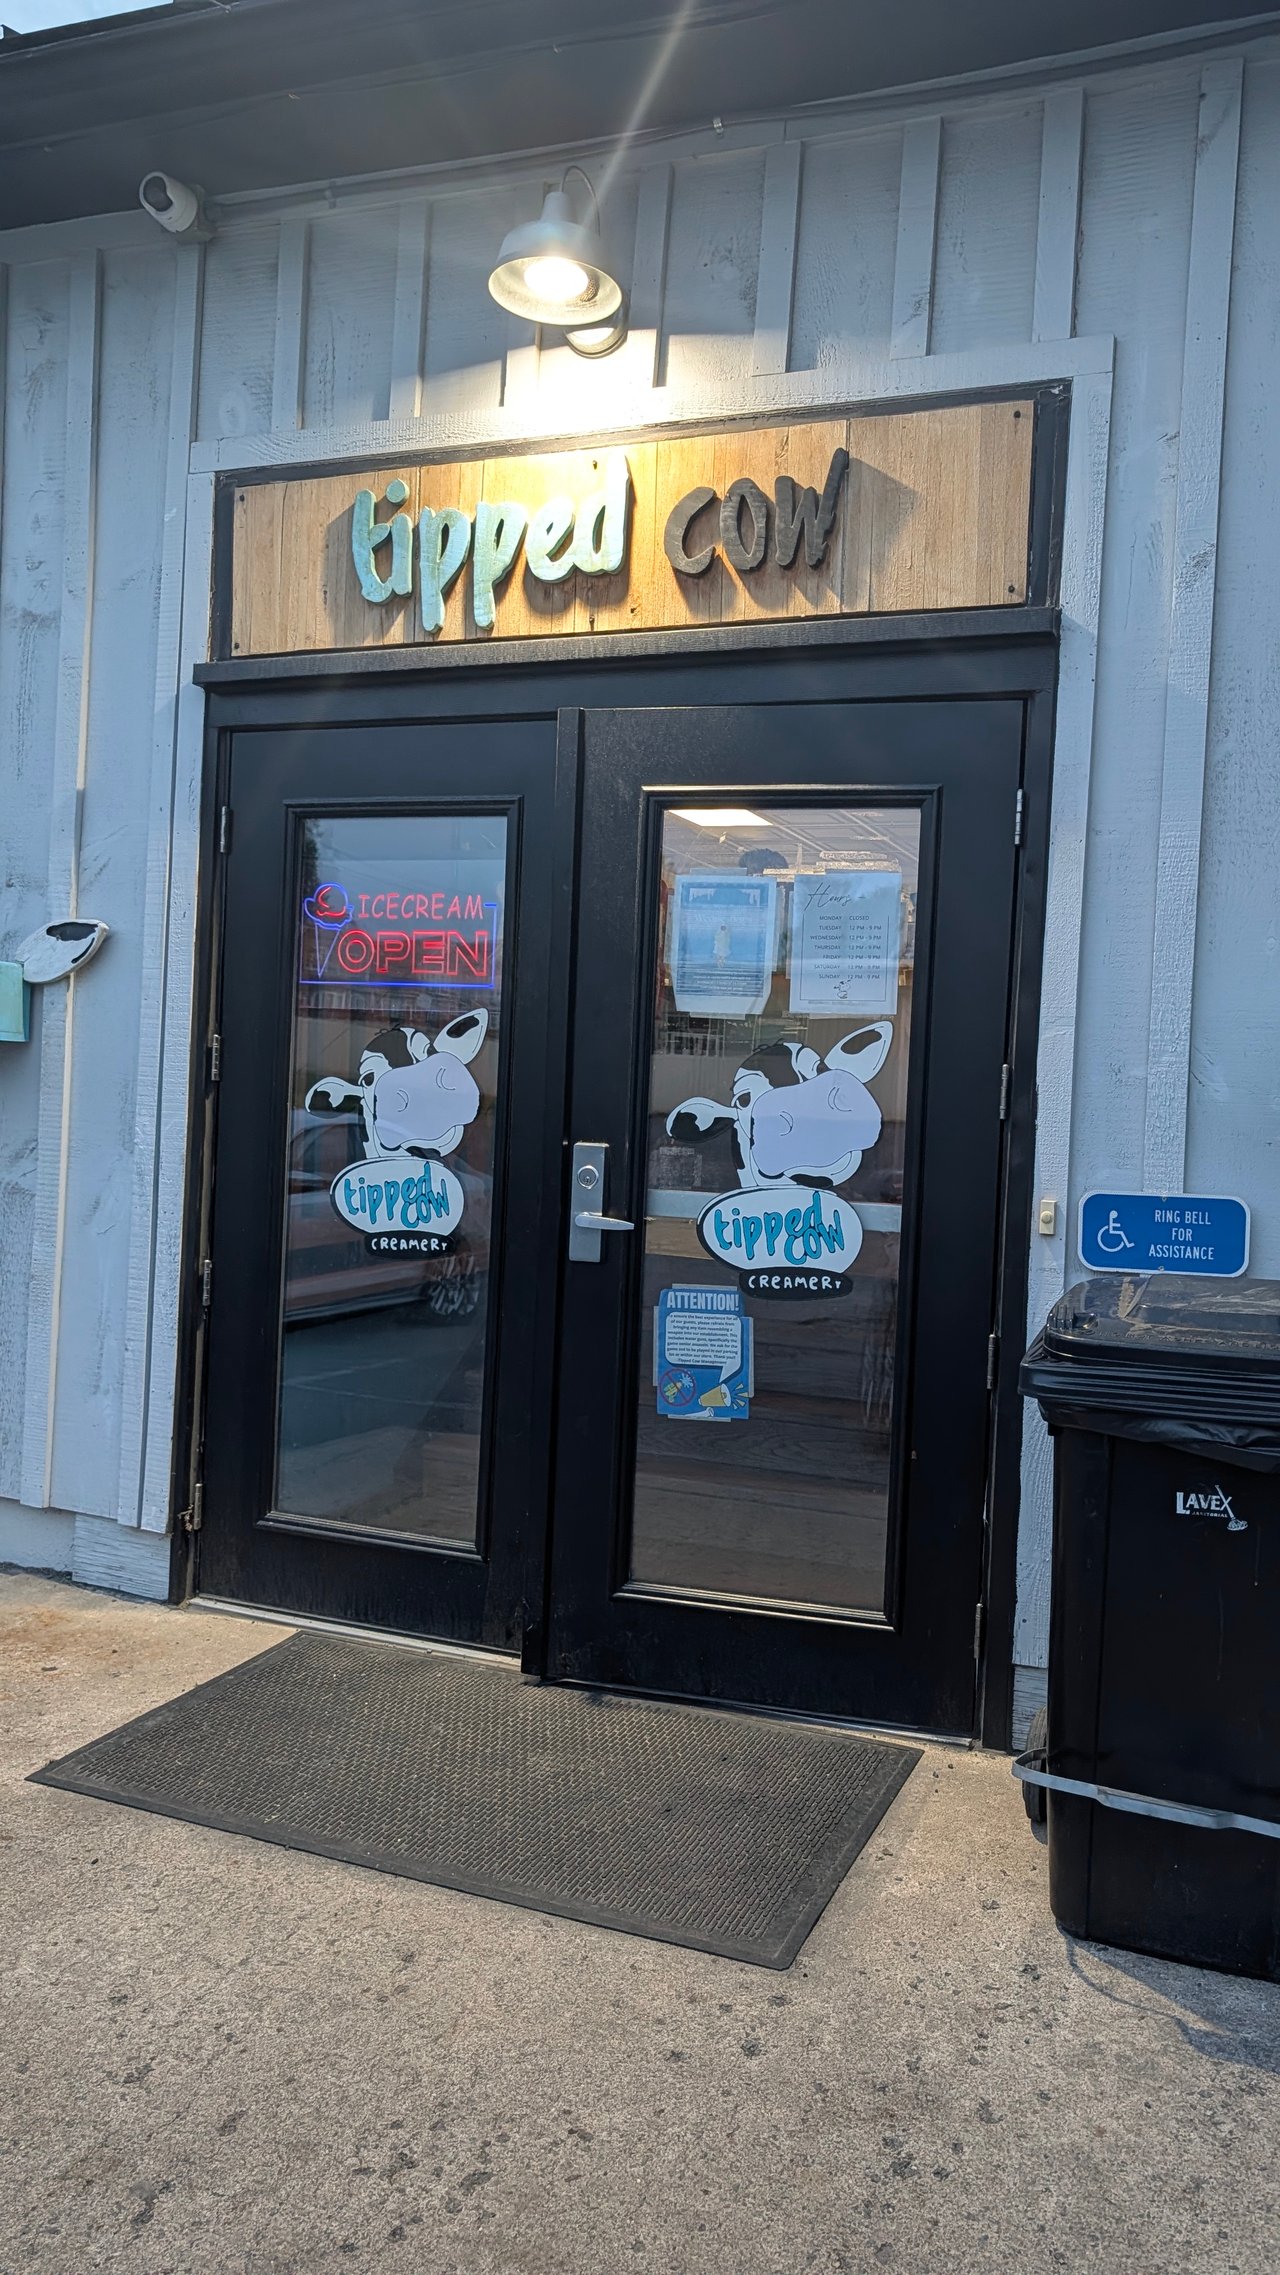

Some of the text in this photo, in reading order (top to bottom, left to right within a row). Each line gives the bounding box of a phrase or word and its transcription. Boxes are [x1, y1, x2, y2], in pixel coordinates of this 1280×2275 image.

[351, 452, 633, 634] tipped
[358, 893, 483, 919] ICECREAM
[337, 930, 489, 976] OPEN
[344, 1161, 432, 1225] tipped
[714, 1190, 822, 1260] tipped
[1155, 1209, 1212, 1225] RING BELL
[1171, 1227, 1193, 1242] FOR
[1148, 1244, 1215, 1260] ASSISTANCE
[666, 1291, 740, 1312] ATTENTION!
[1176, 1486, 1234, 1515] LAVEX
